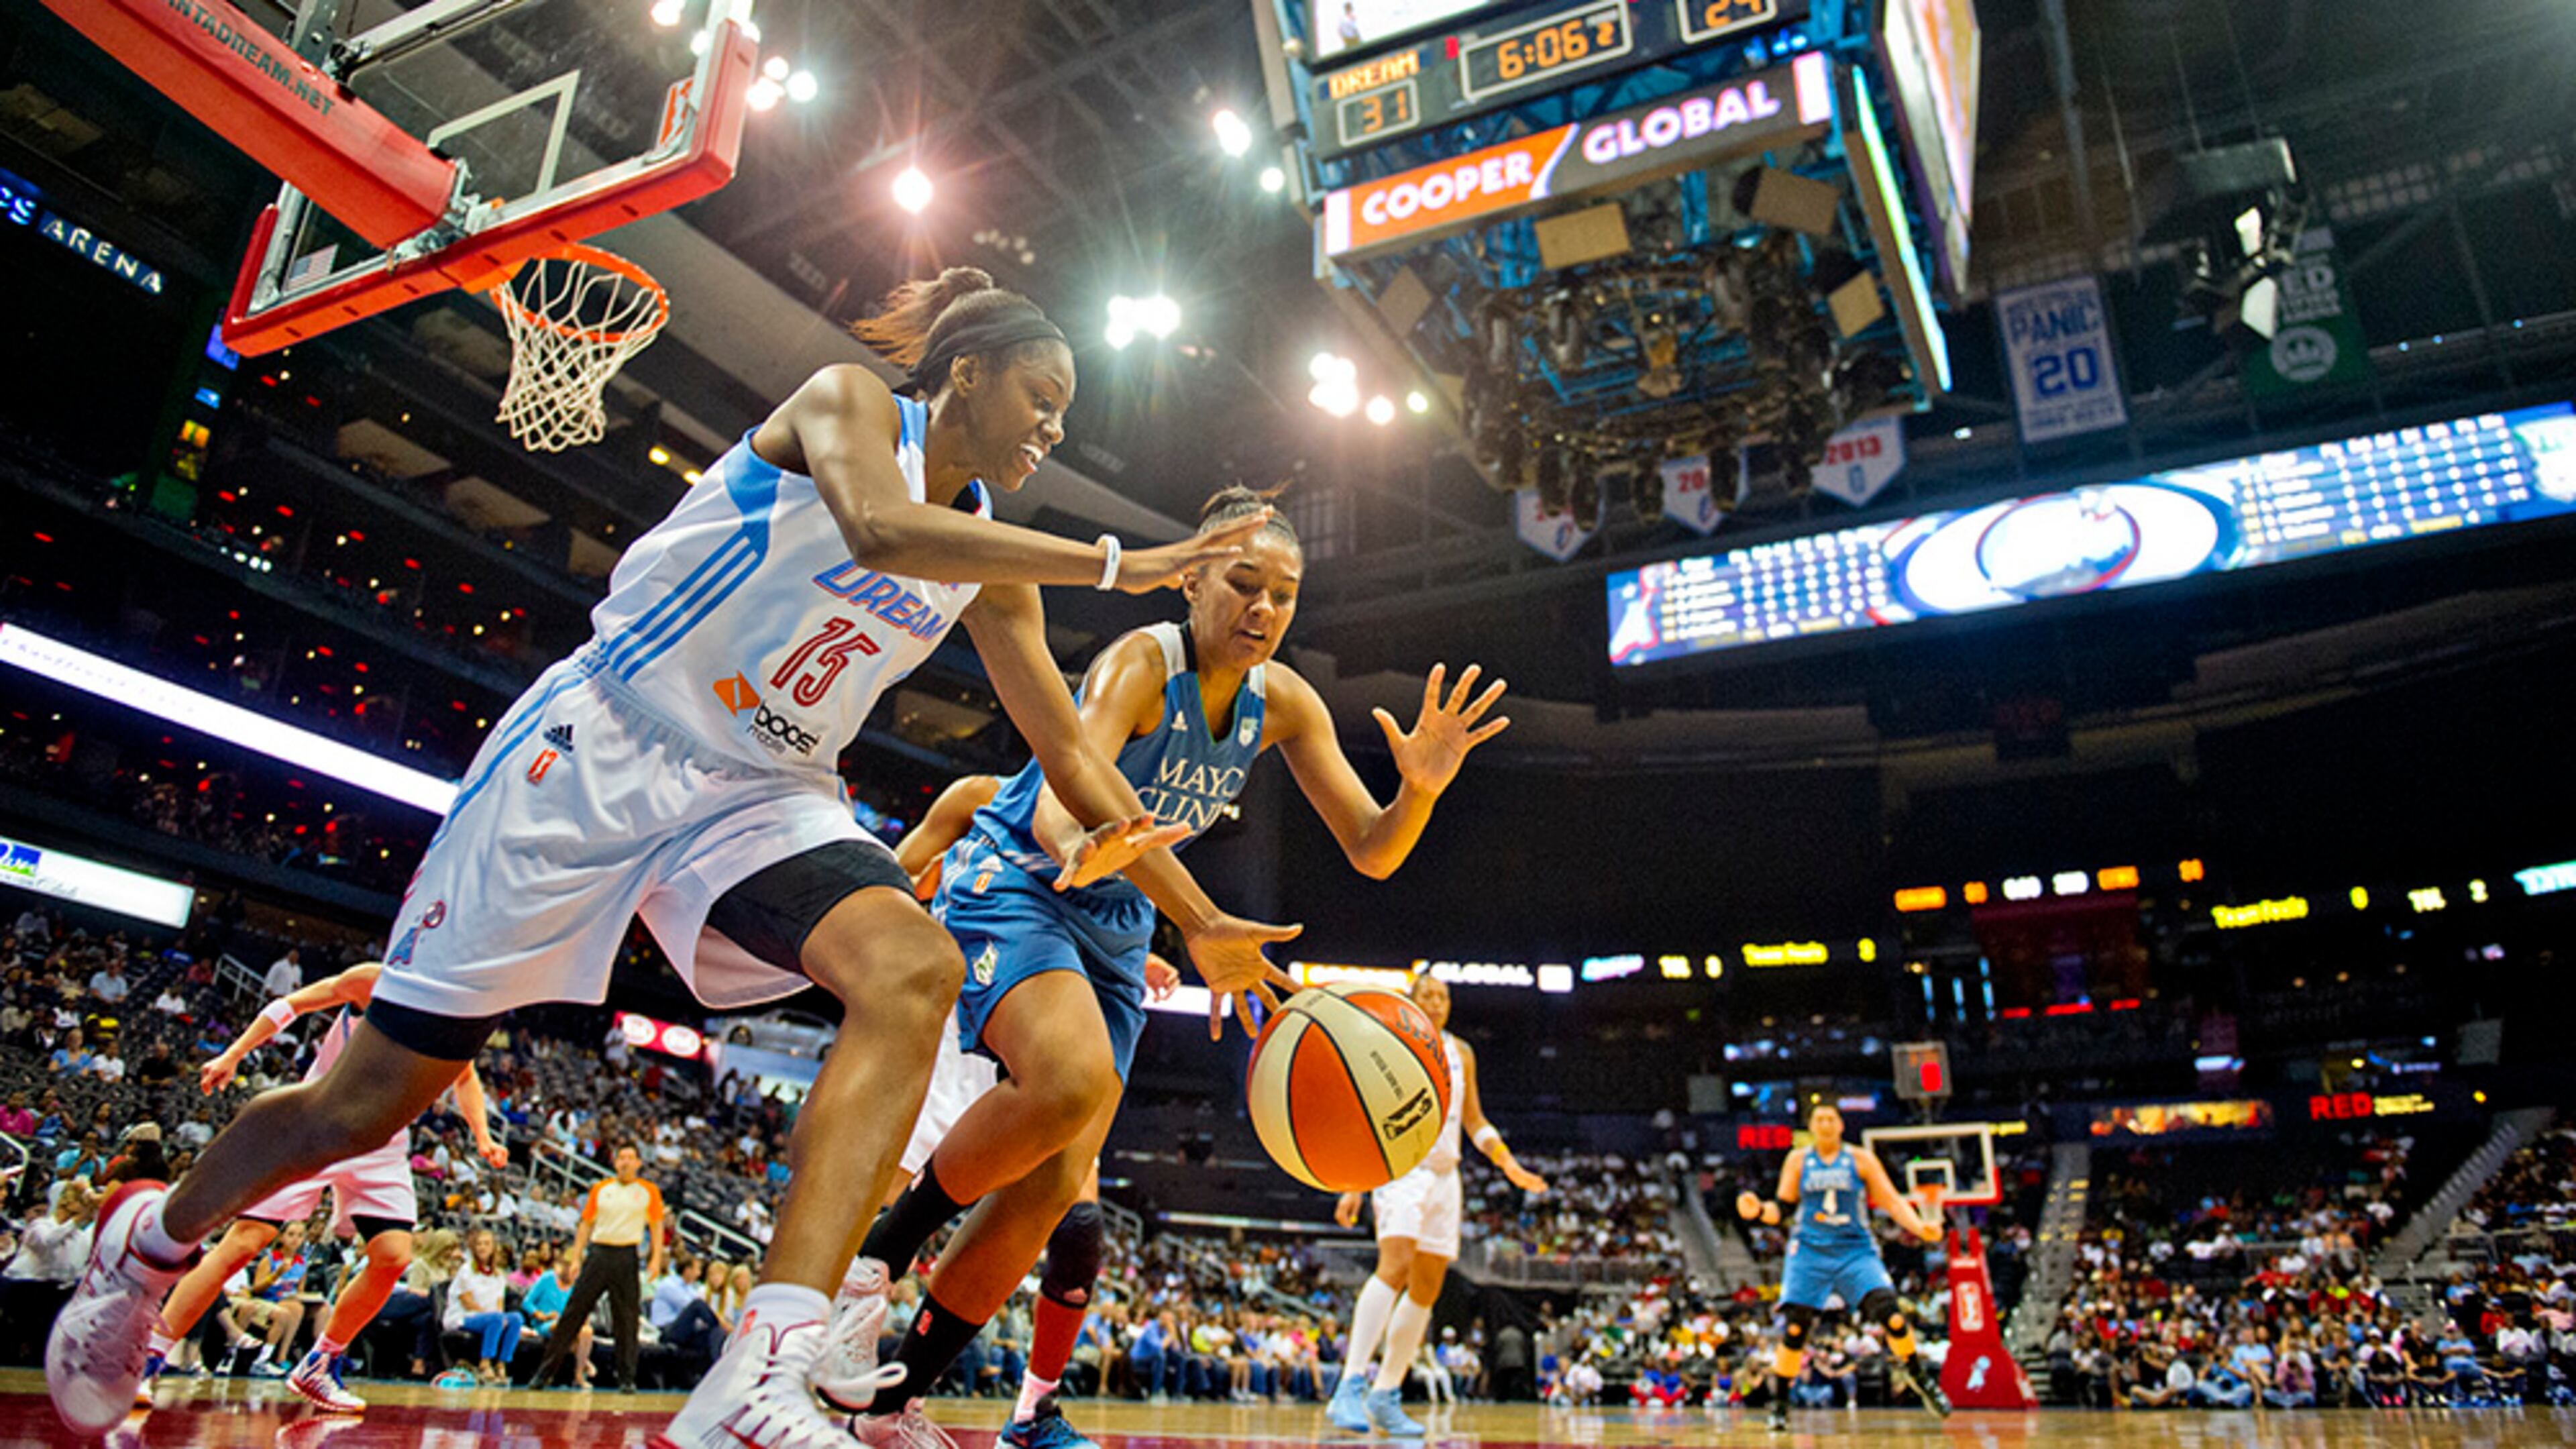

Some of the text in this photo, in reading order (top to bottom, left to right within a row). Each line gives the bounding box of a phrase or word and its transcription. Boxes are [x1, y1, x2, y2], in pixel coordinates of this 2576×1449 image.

[1328, 49, 1419, 99] DREAM
[1497, 19, 1589, 79] 6:06
[1362, 89, 1407, 133] 31
[1360, 80, 1781, 226] COOPER GLOBAL
[42, 218, 162, 293] ARENA
[2033, 347, 2098, 398] 20
[769, 616, 881, 708] 15
[2310, 1092, 2373, 1121] RED
